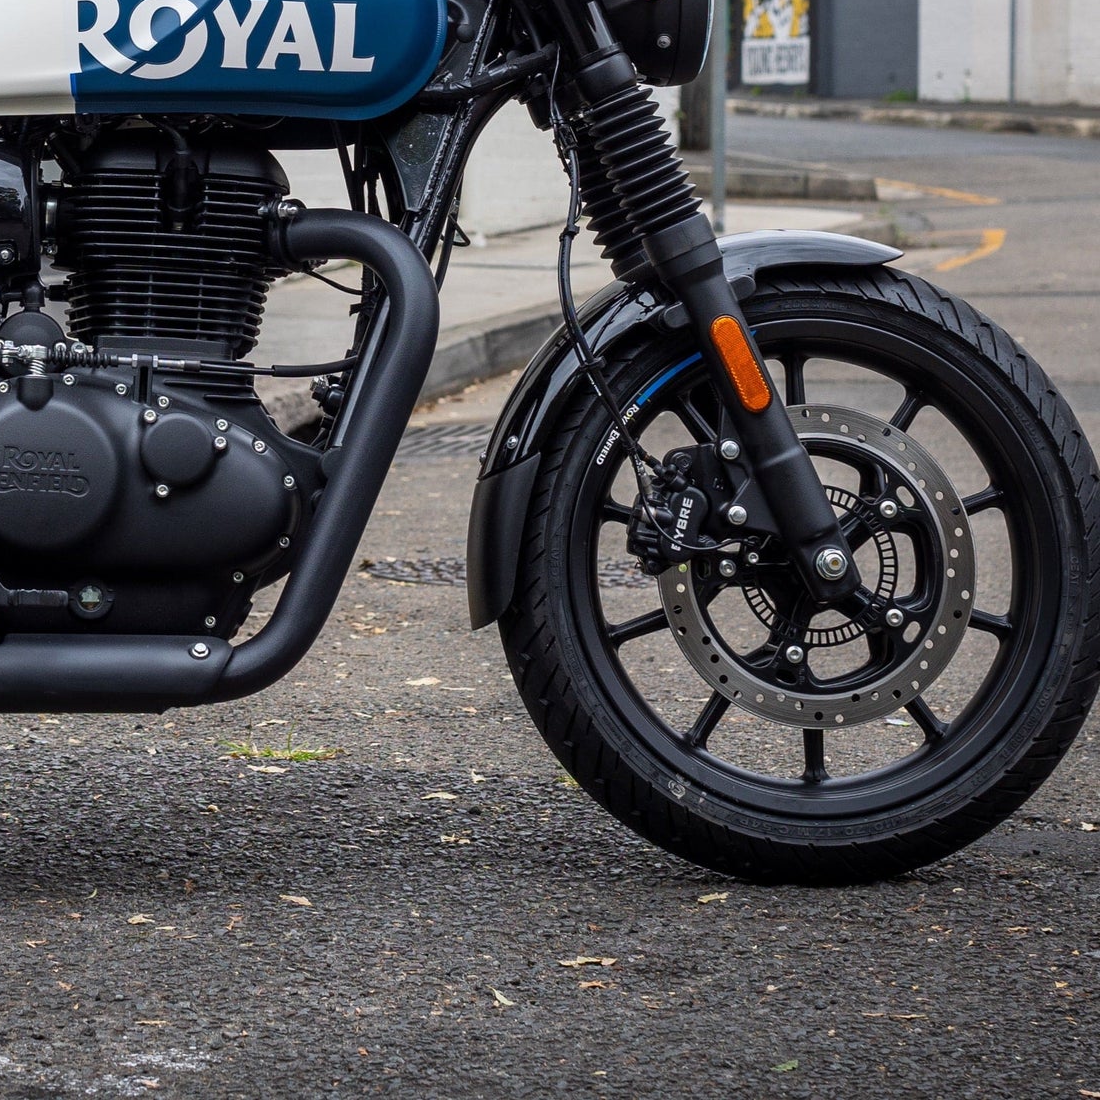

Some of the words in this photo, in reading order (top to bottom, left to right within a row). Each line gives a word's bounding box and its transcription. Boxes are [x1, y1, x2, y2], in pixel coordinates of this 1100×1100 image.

[615, 404, 640, 429] ROY
[3, 445, 80, 473] ROYAL
[596, 429, 620, 466] ENFIELD
